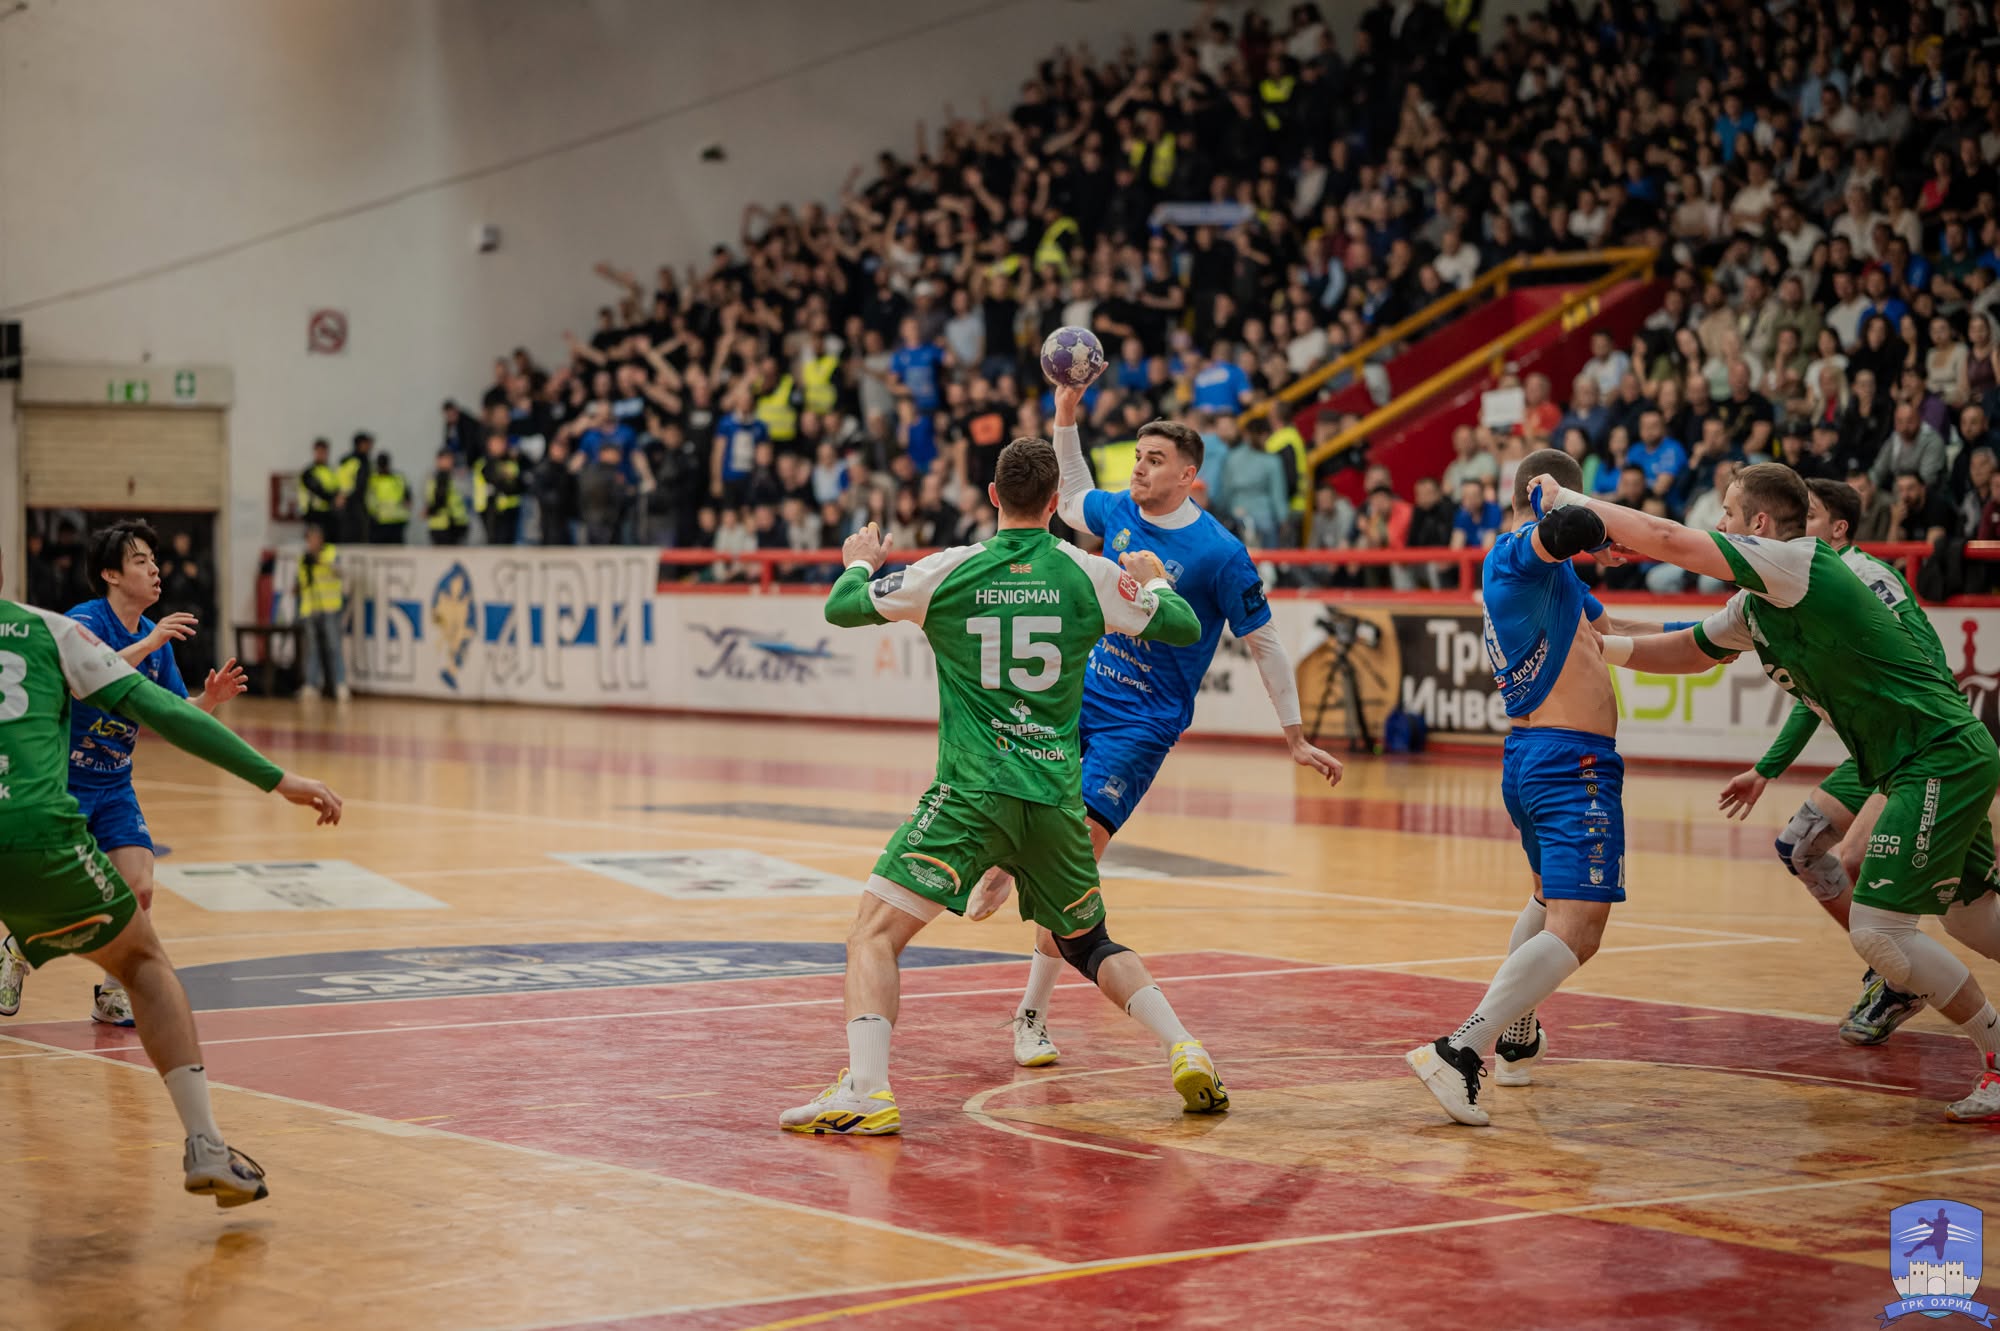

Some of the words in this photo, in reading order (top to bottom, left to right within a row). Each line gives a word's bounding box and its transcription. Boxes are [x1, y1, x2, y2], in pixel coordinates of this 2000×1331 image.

[975, 589, 1060, 604] HENIGMAN
[966, 616, 1062, 692] 15
[1920, 778, 1938, 832] PELISTER
[1915, 832, 1927, 850] GP
[296, 960, 832, 997] BASKETBALL
[322, 956, 731, 986] OHRID
